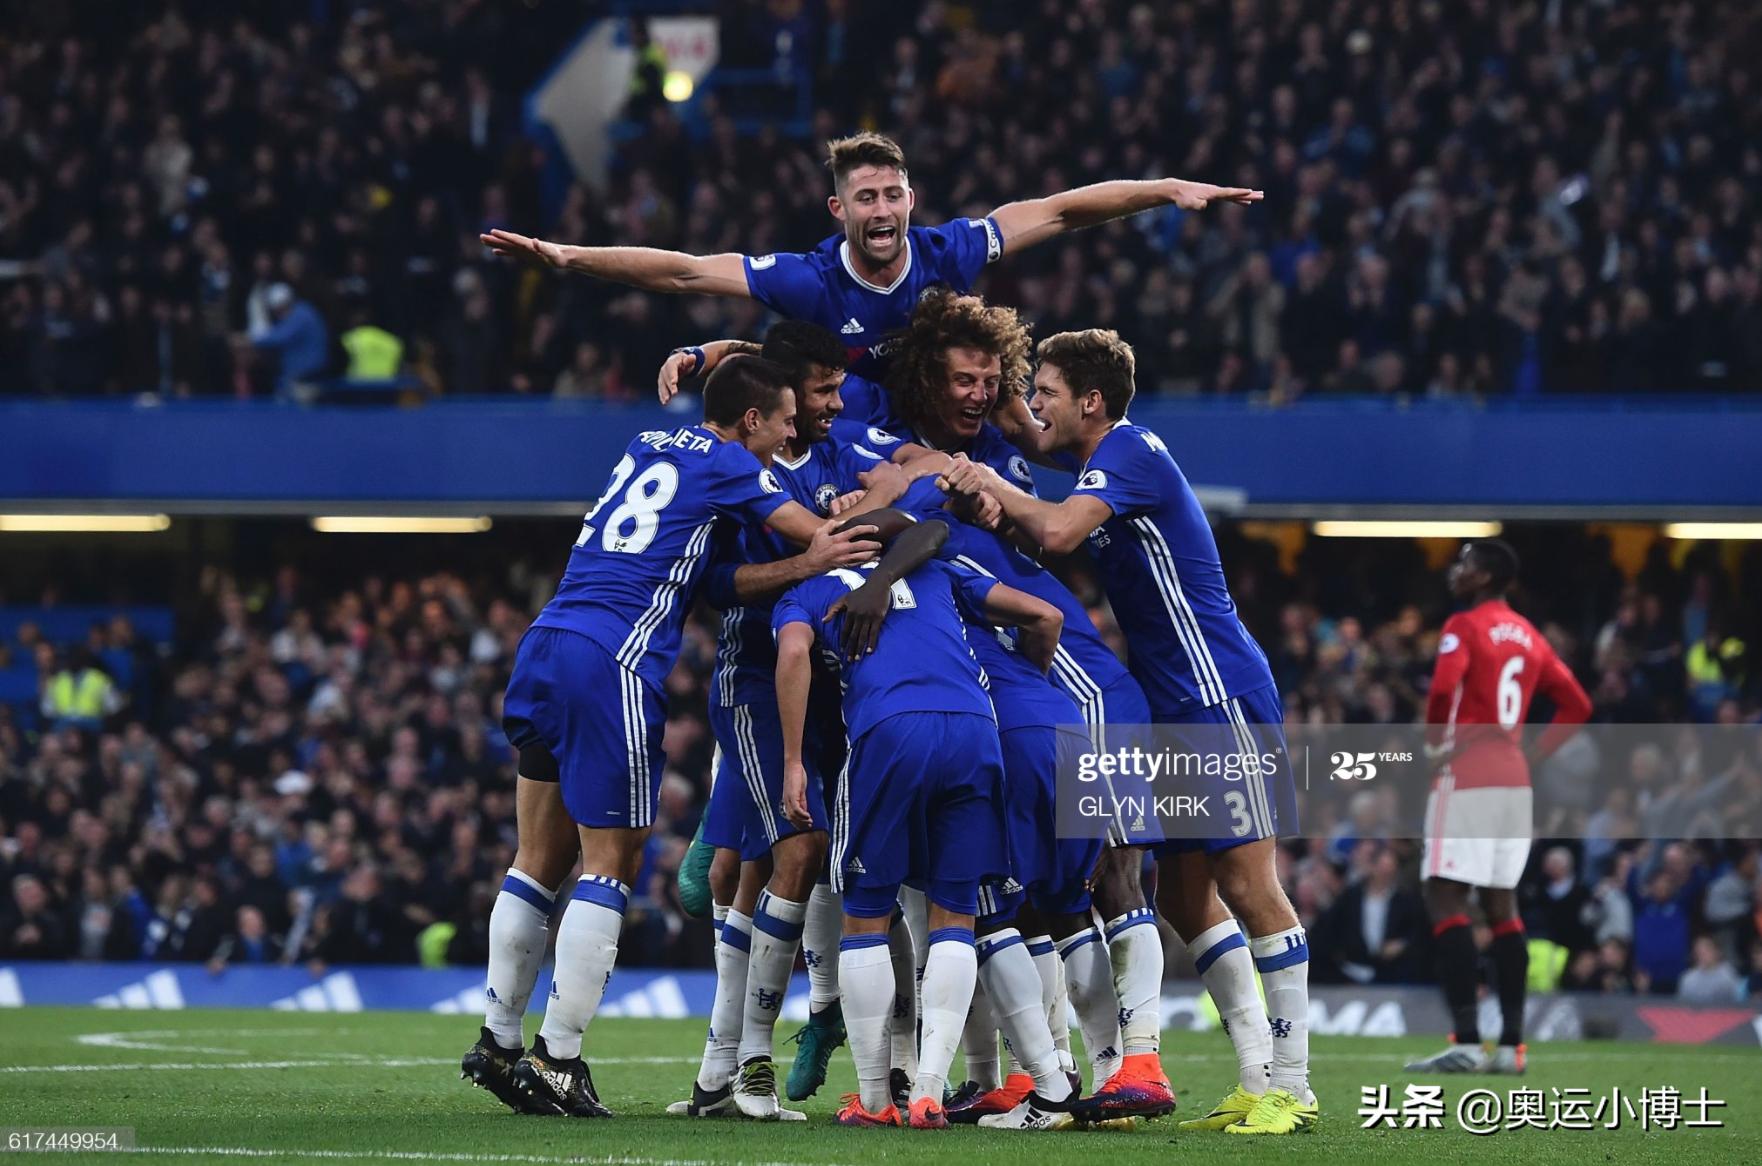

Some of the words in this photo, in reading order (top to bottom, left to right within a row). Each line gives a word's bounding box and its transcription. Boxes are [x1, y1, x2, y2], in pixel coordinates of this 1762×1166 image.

[574, 452, 679, 554] 28
[1497, 656, 1525, 731] 6
[1224, 790, 1252, 837] 3
